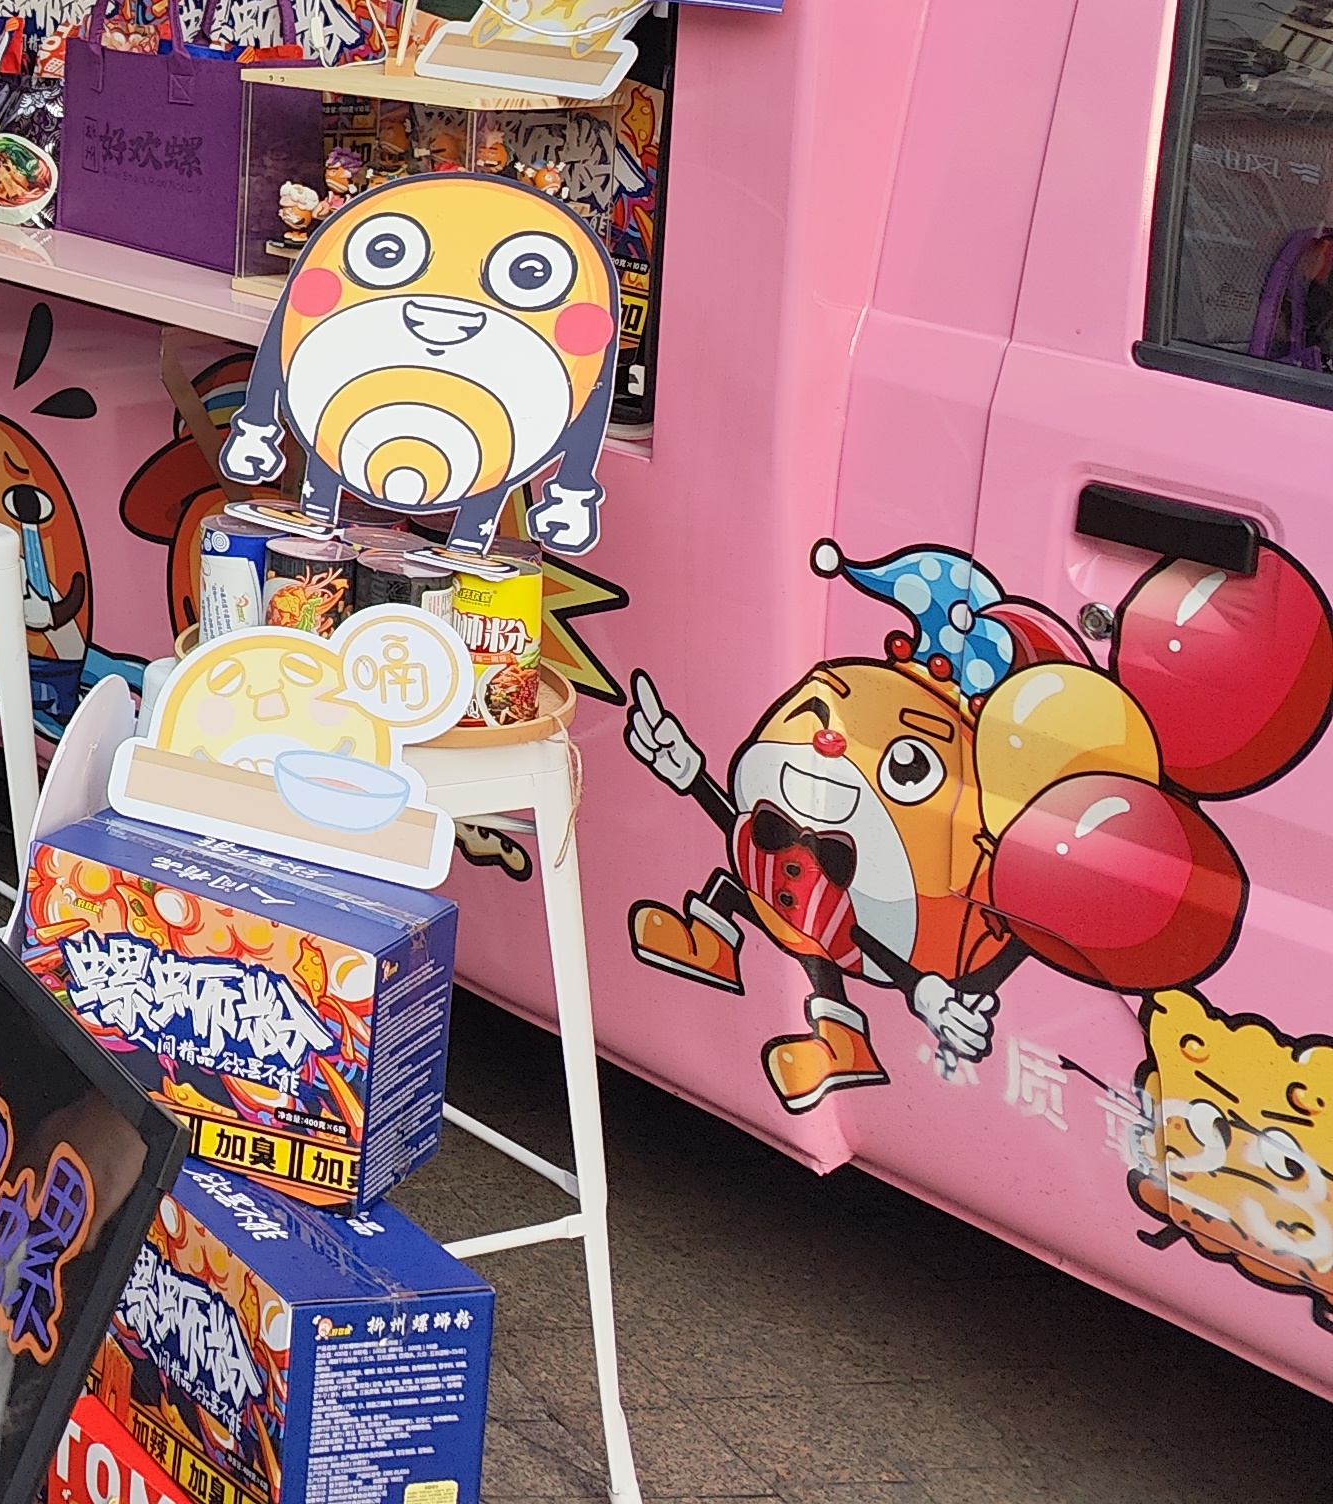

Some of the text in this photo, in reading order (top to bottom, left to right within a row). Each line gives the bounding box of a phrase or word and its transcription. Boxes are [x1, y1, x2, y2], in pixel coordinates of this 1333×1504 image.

[100, 122, 203, 178] 好欢螺
[65, 934, 334, 1066] 螺蛳粉
[213, 1129, 276, 1170] 加臭
[131, 1413, 168, 1465] 加辣
